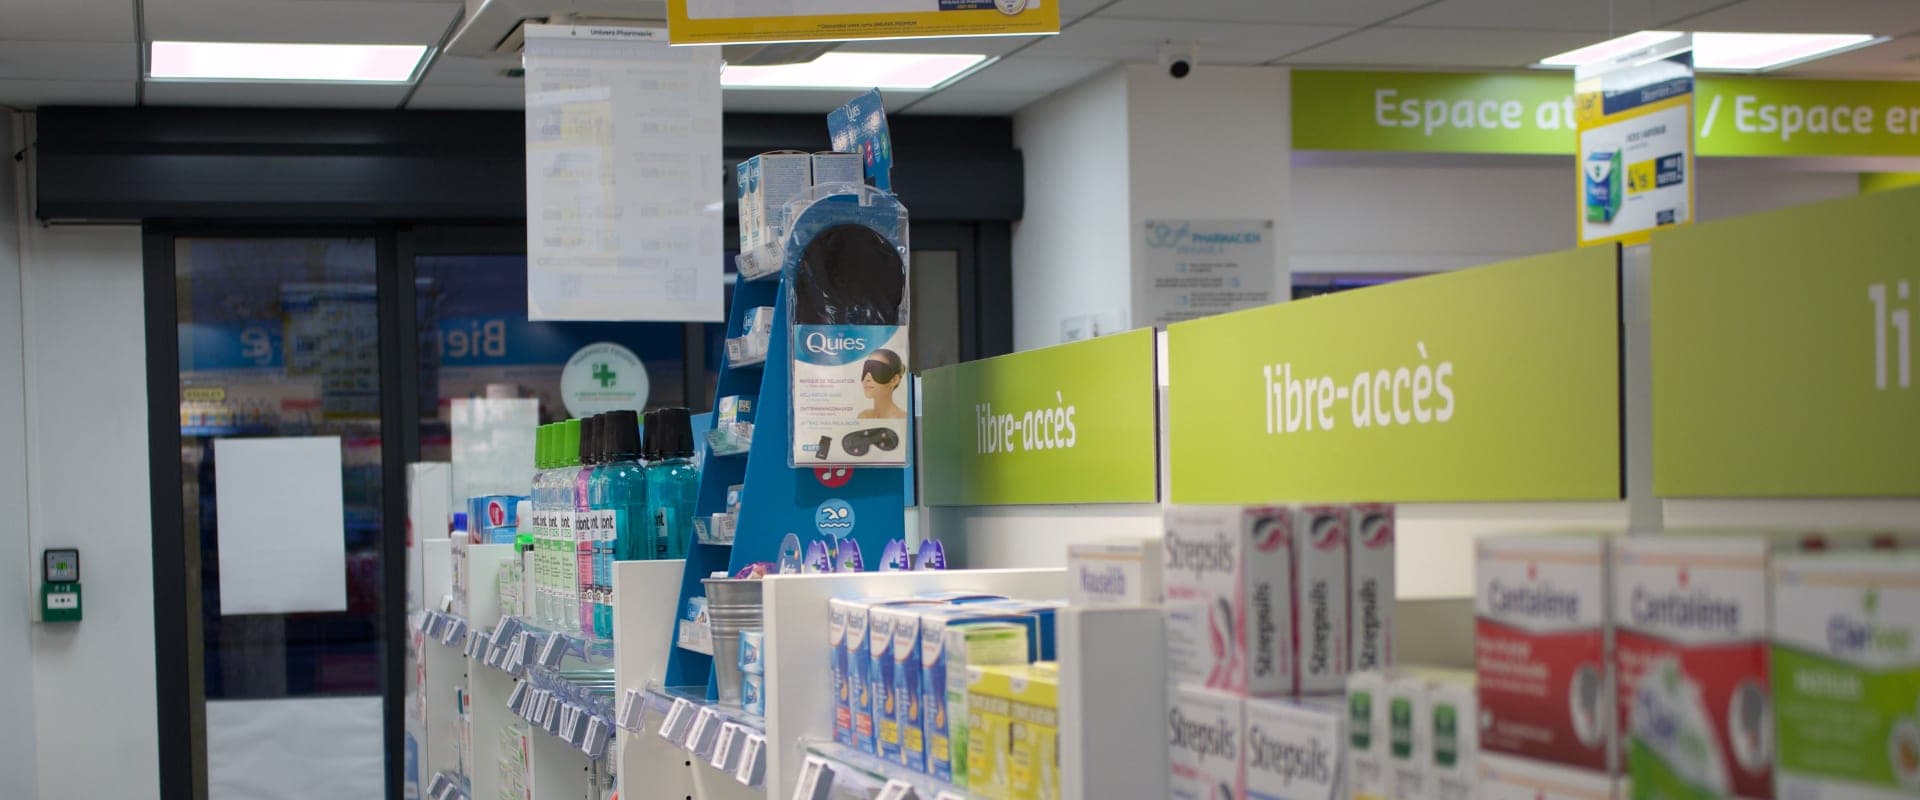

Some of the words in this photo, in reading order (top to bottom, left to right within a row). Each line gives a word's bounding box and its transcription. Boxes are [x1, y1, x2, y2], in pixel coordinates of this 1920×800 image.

[616, 29, 652, 37] Pharmacie
[1374, 88, 1524, 137] Espace
[1733, 94, 1874, 141] Espace
[806, 332, 866, 356] Quies
[1263, 342, 1455, 435] libre-accès
[975, 390, 1076, 454] libre-accès
[1165, 531, 1234, 580] Strepsils
[1253, 582, 1275, 677] Strepsils
[1309, 581, 1330, 675] Strepsils
[1359, 578, 1380, 671] Strepsils
[1169, 706, 1236, 763] Strepsils
[1249, 724, 1330, 786] Strepsils
